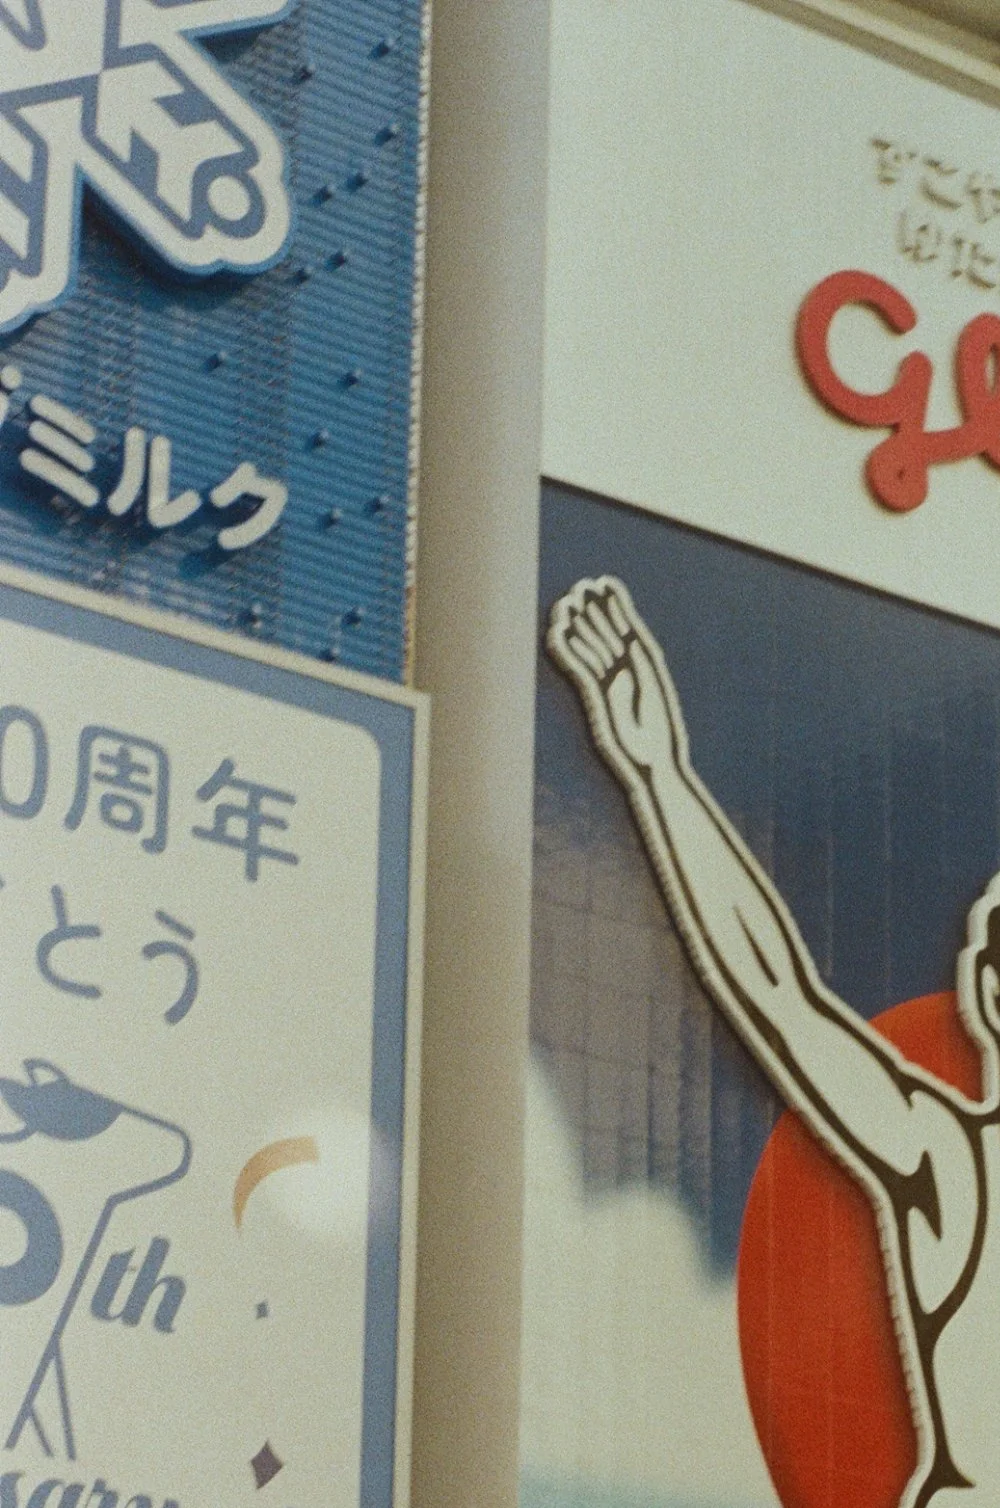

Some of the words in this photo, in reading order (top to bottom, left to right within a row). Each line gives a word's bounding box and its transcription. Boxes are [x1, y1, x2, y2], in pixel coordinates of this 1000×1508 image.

[0, 365, 288, 550] ミルク
[0, 876, 198, 1026] とう
